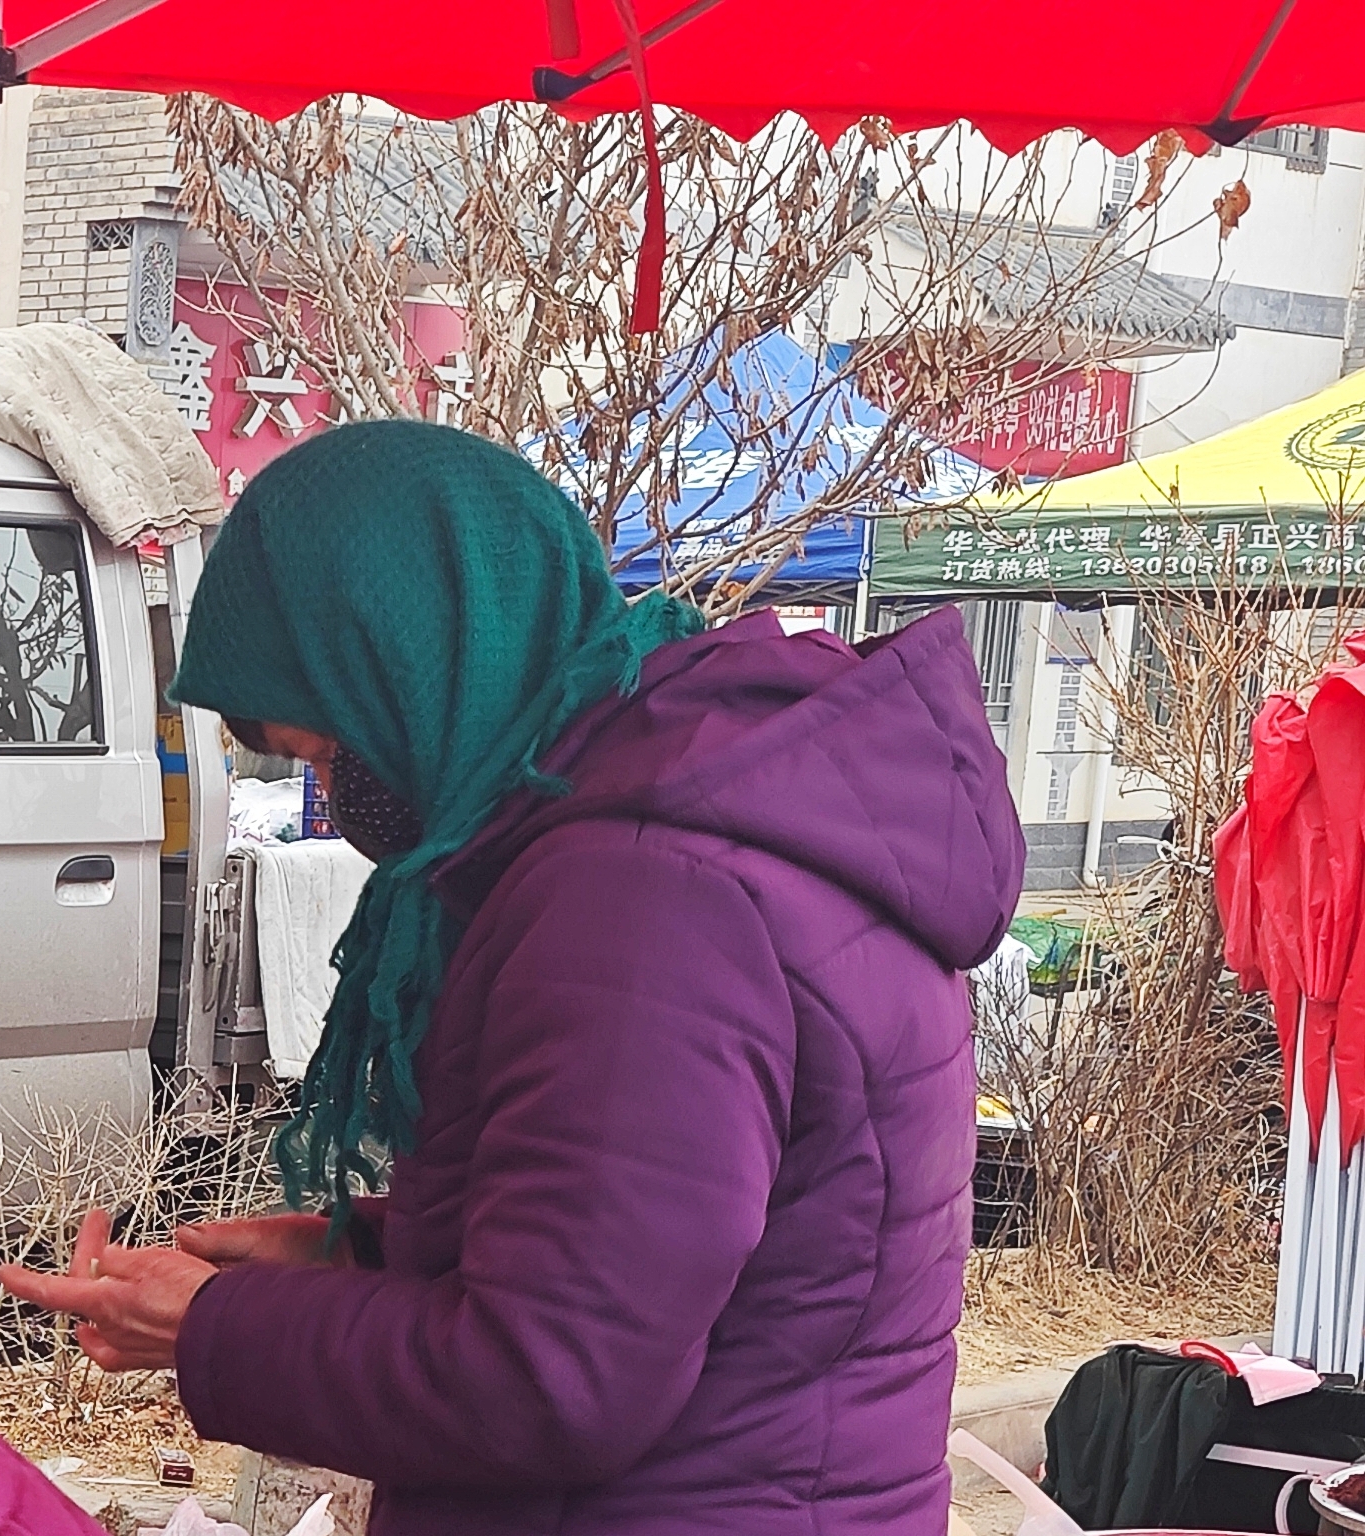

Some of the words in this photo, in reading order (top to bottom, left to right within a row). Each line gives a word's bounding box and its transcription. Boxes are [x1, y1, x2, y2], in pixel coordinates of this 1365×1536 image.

[942, 526, 1112, 558] 华亭总代理
[1139, 523, 1365, 552] 华亭县正兴商
